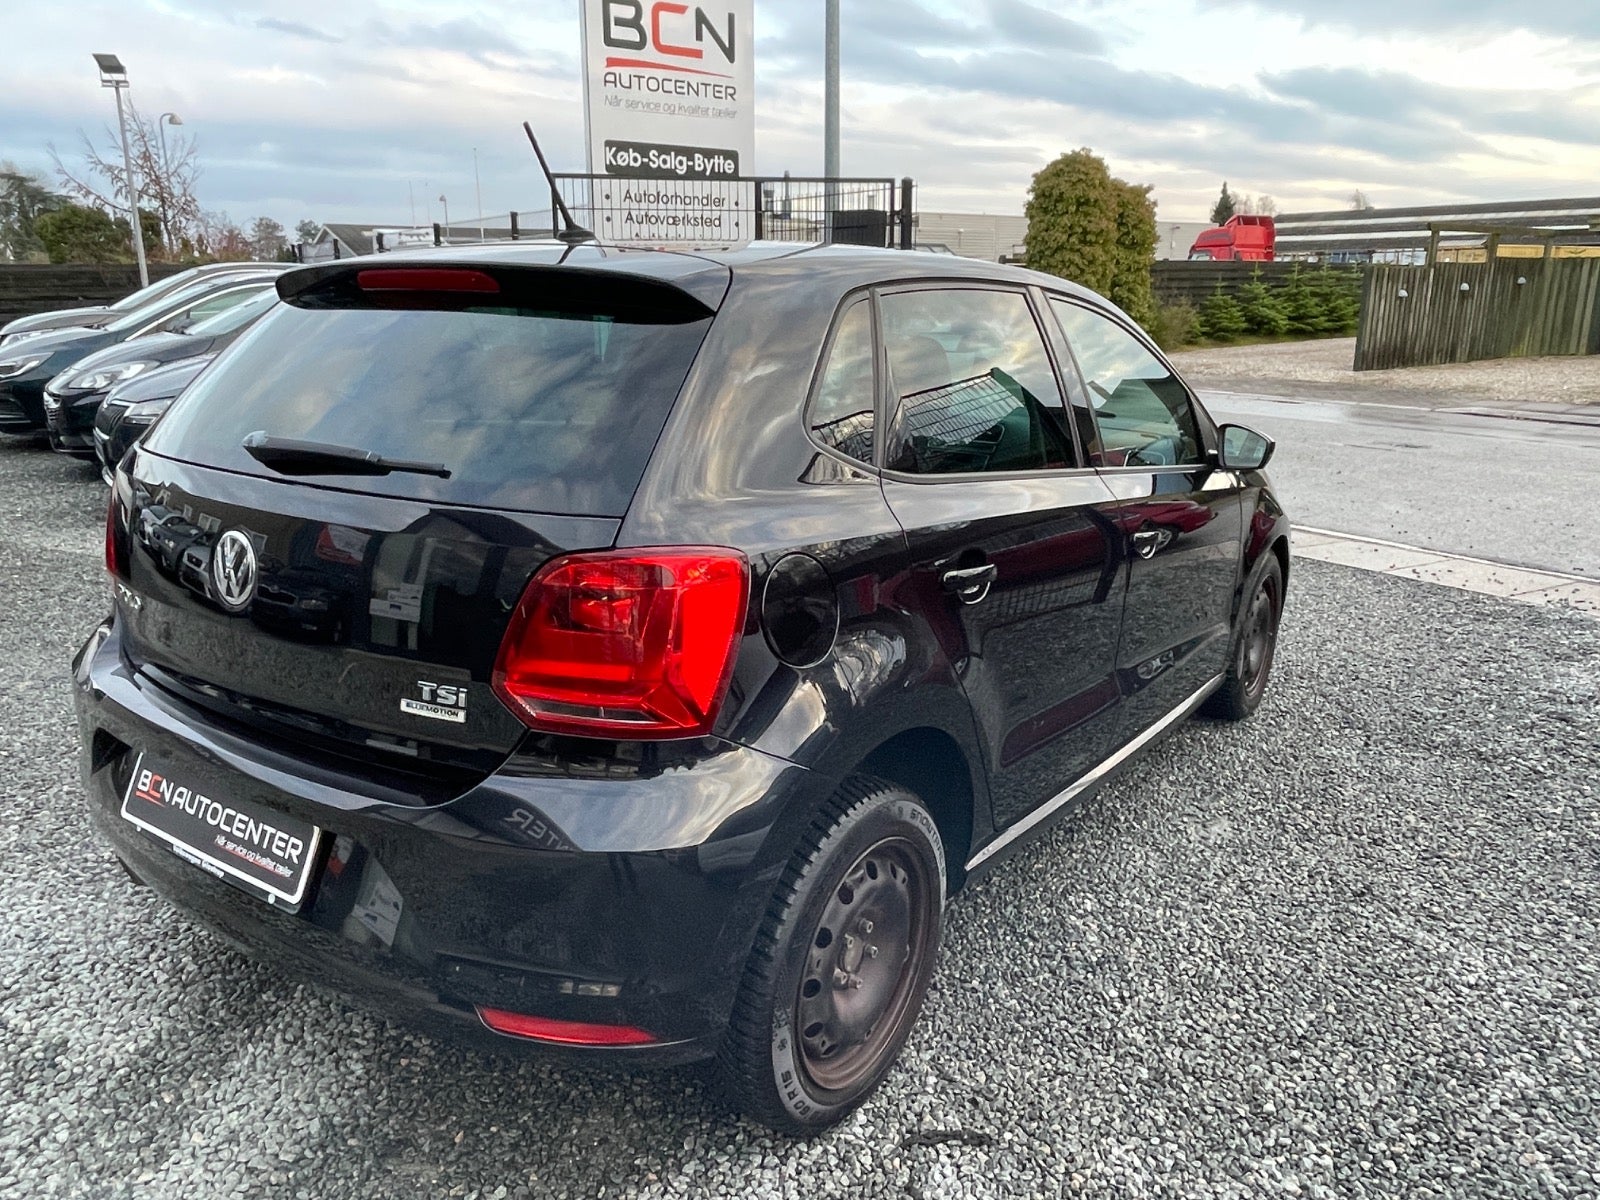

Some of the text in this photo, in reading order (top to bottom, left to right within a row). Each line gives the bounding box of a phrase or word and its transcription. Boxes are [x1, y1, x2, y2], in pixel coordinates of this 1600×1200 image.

[602, 0, 735, 64] BCN
[603, 71, 737, 102] AUTOCENTER
[604, 95, 622, 107] Når
[624, 98, 661, 111] service
[662, 103, 676, 115] og
[677, 102, 710, 116] kvalitet
[605, 146, 735, 176] Køb-Salg-Bytte
[623, 189, 726, 208] Autoforhandler
[624, 211, 721, 228] Autoværksted
[137, 769, 304, 865] BCN AUTOCENTER
